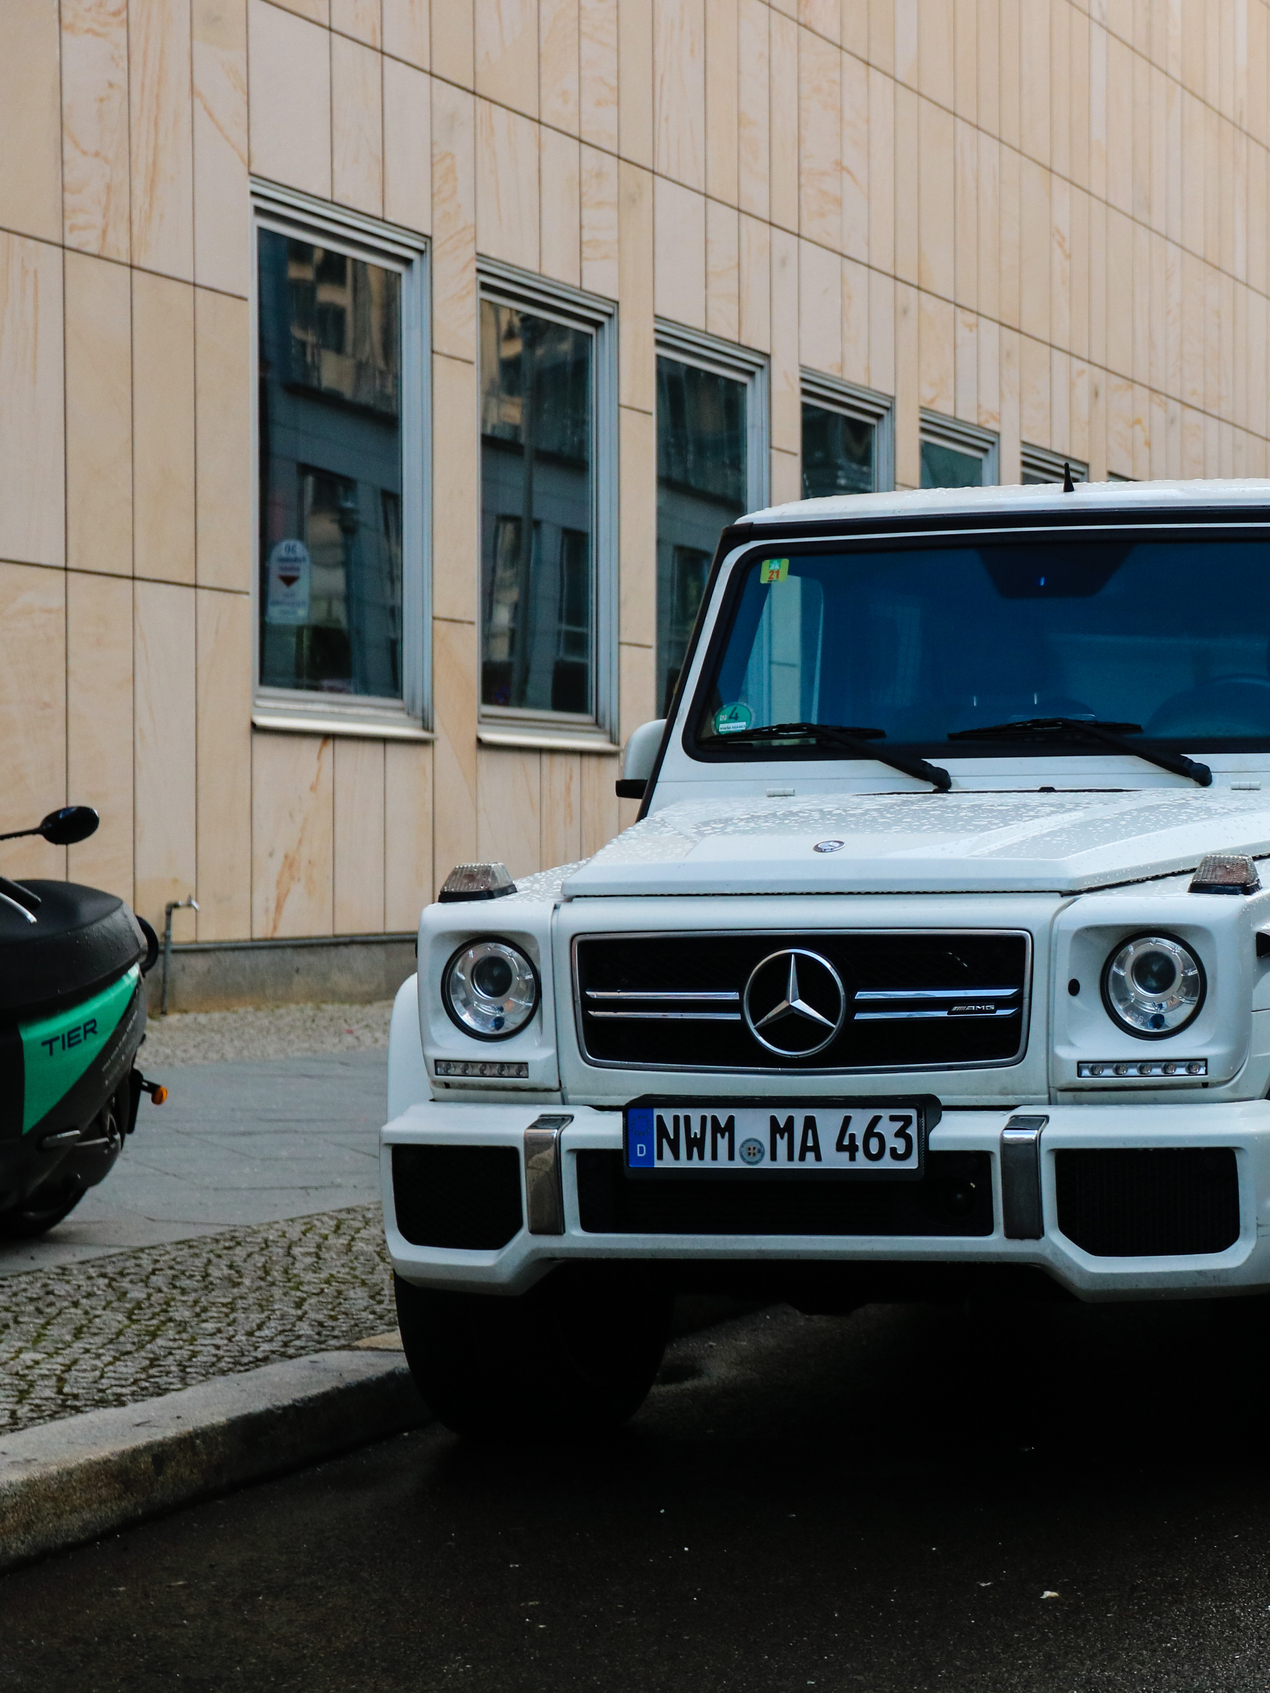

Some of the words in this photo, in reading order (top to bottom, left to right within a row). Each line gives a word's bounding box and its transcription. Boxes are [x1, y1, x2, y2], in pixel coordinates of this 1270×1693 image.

[768, 570, 780, 580] 21
[728, 706, 739, 721] 4
[41, 1018, 98, 1057] TIER
[636, 1143, 647, 1157] D
[656, 1114, 735, 1162] NWM
[769, 1114, 823, 1162] MA
[835, 1114, 914, 1162] 463
